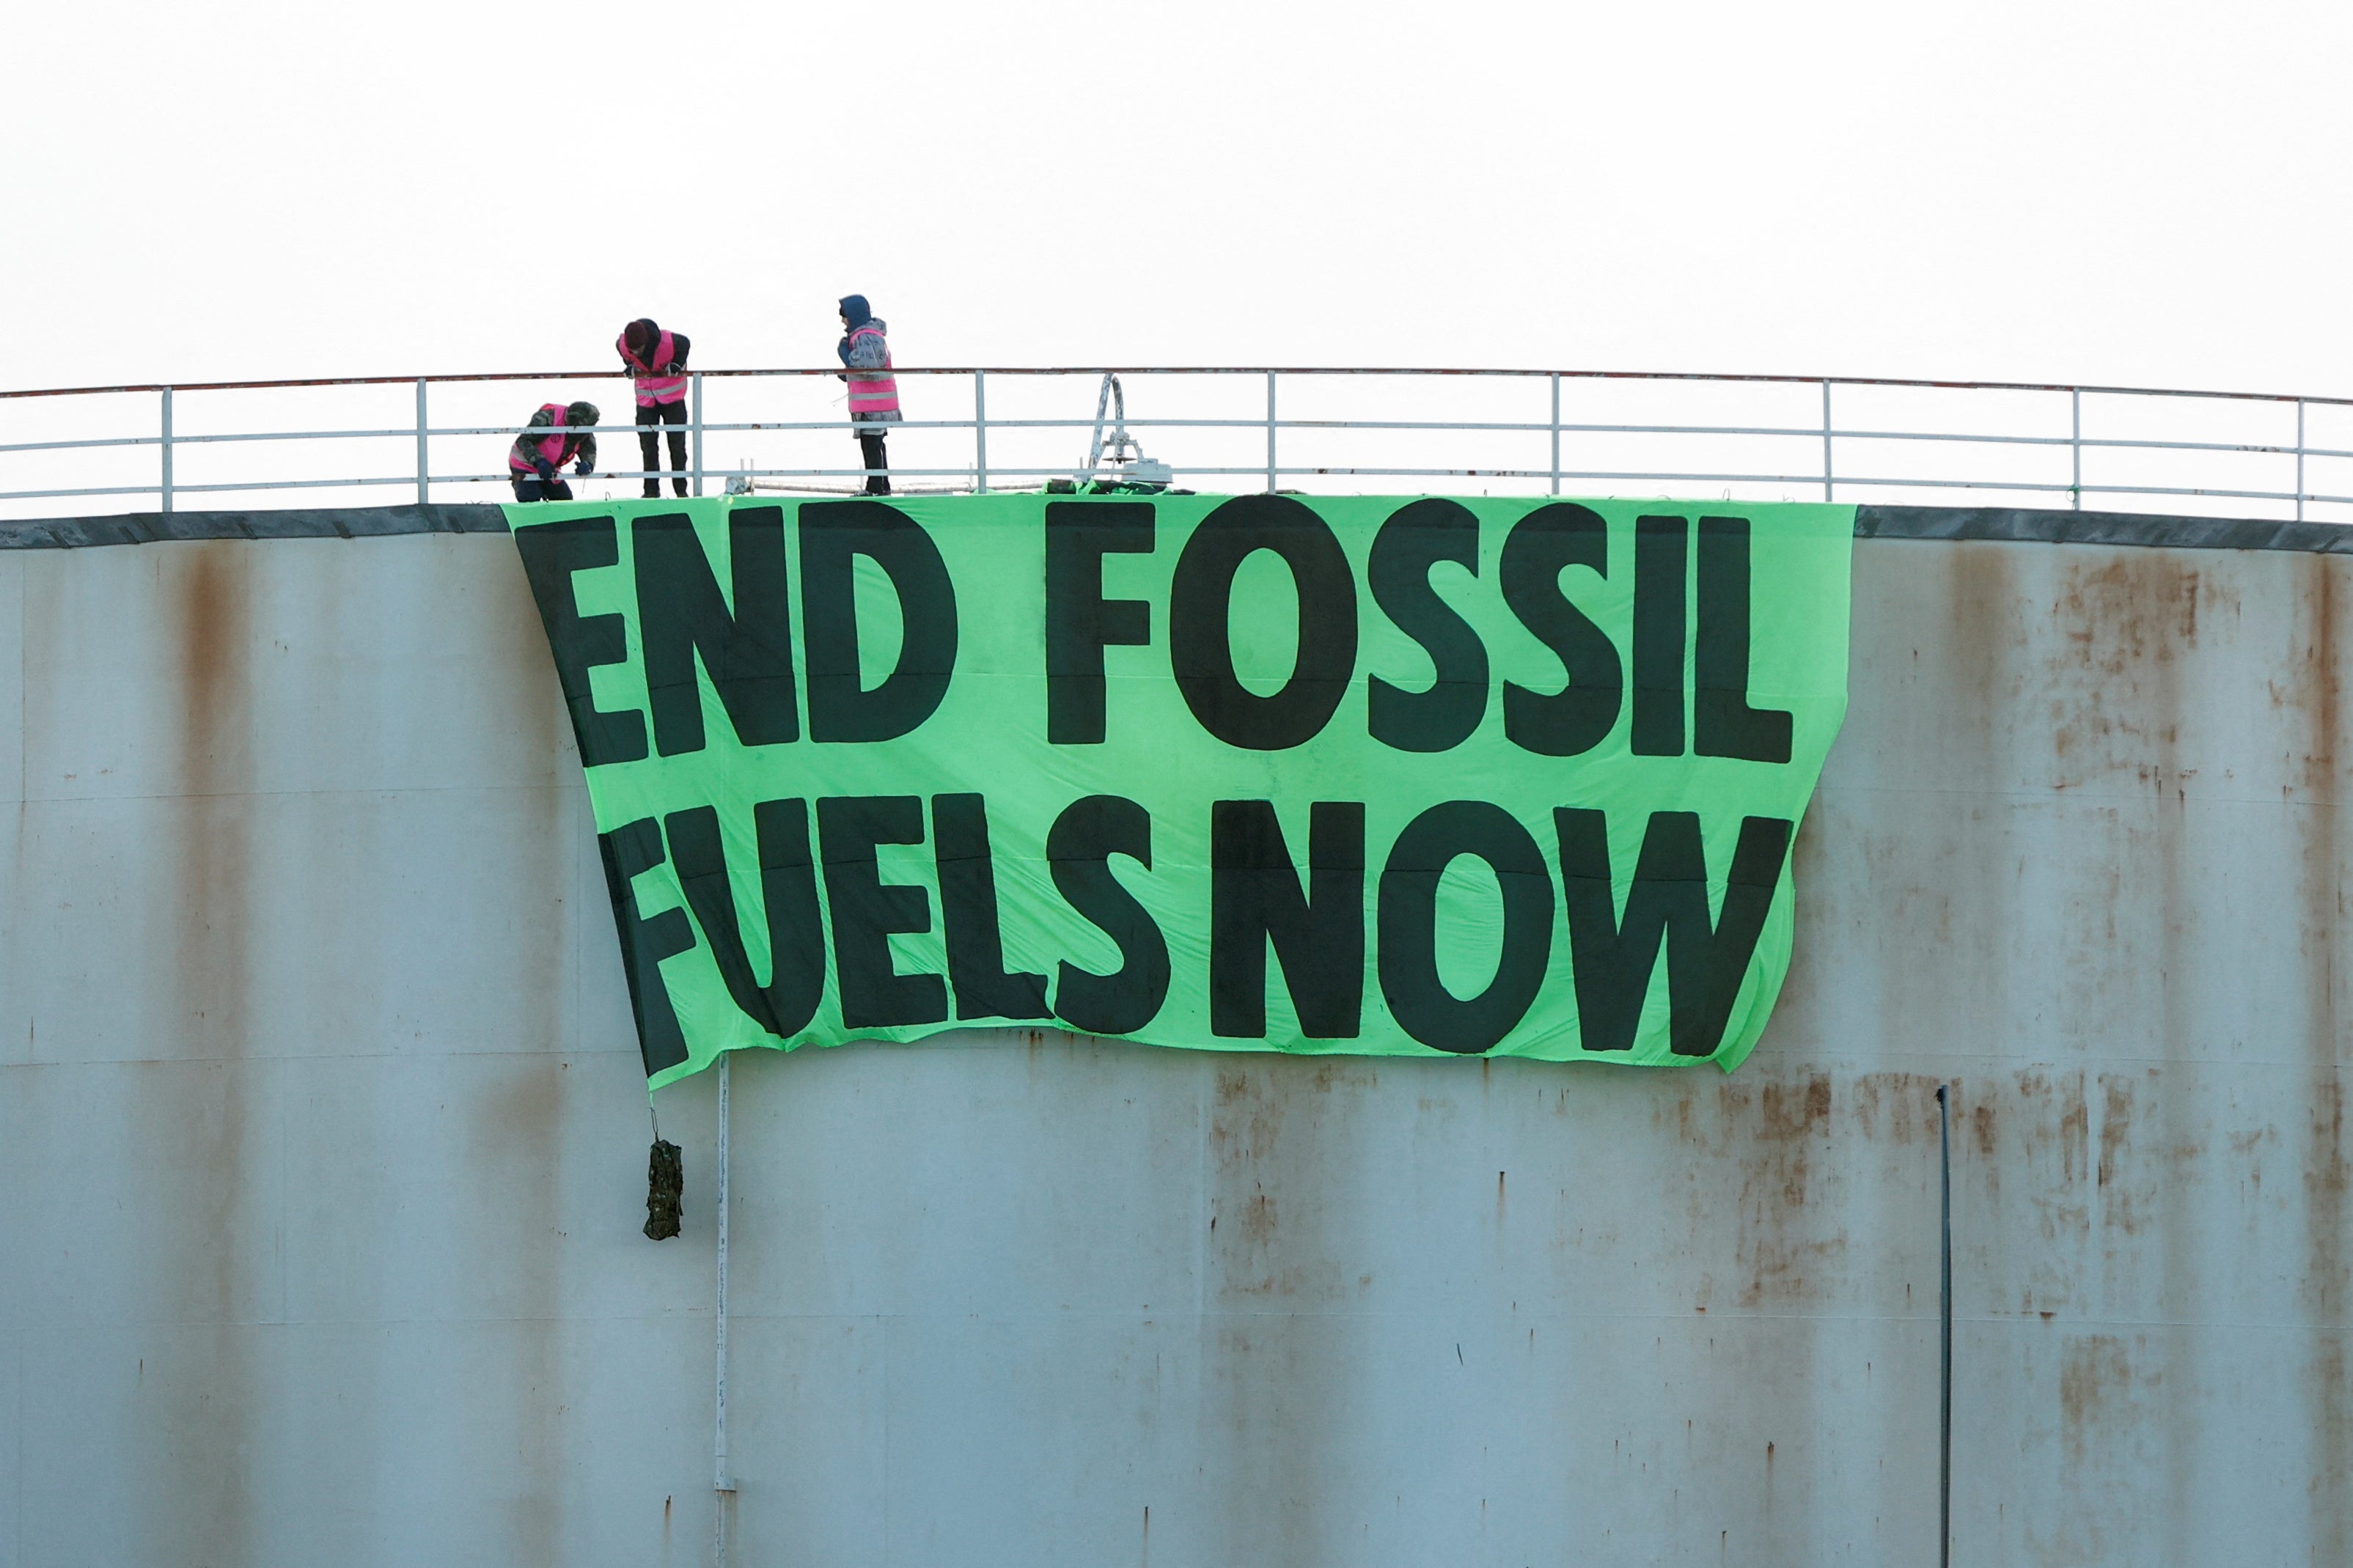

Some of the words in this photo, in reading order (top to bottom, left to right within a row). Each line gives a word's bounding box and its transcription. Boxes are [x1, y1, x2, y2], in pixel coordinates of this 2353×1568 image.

[514, 501, 958, 768] END
[1045, 495, 1793, 763] FOSSIL
[598, 793, 1171, 1078] FUELS
[1211, 800, 1794, 1056] NOW
